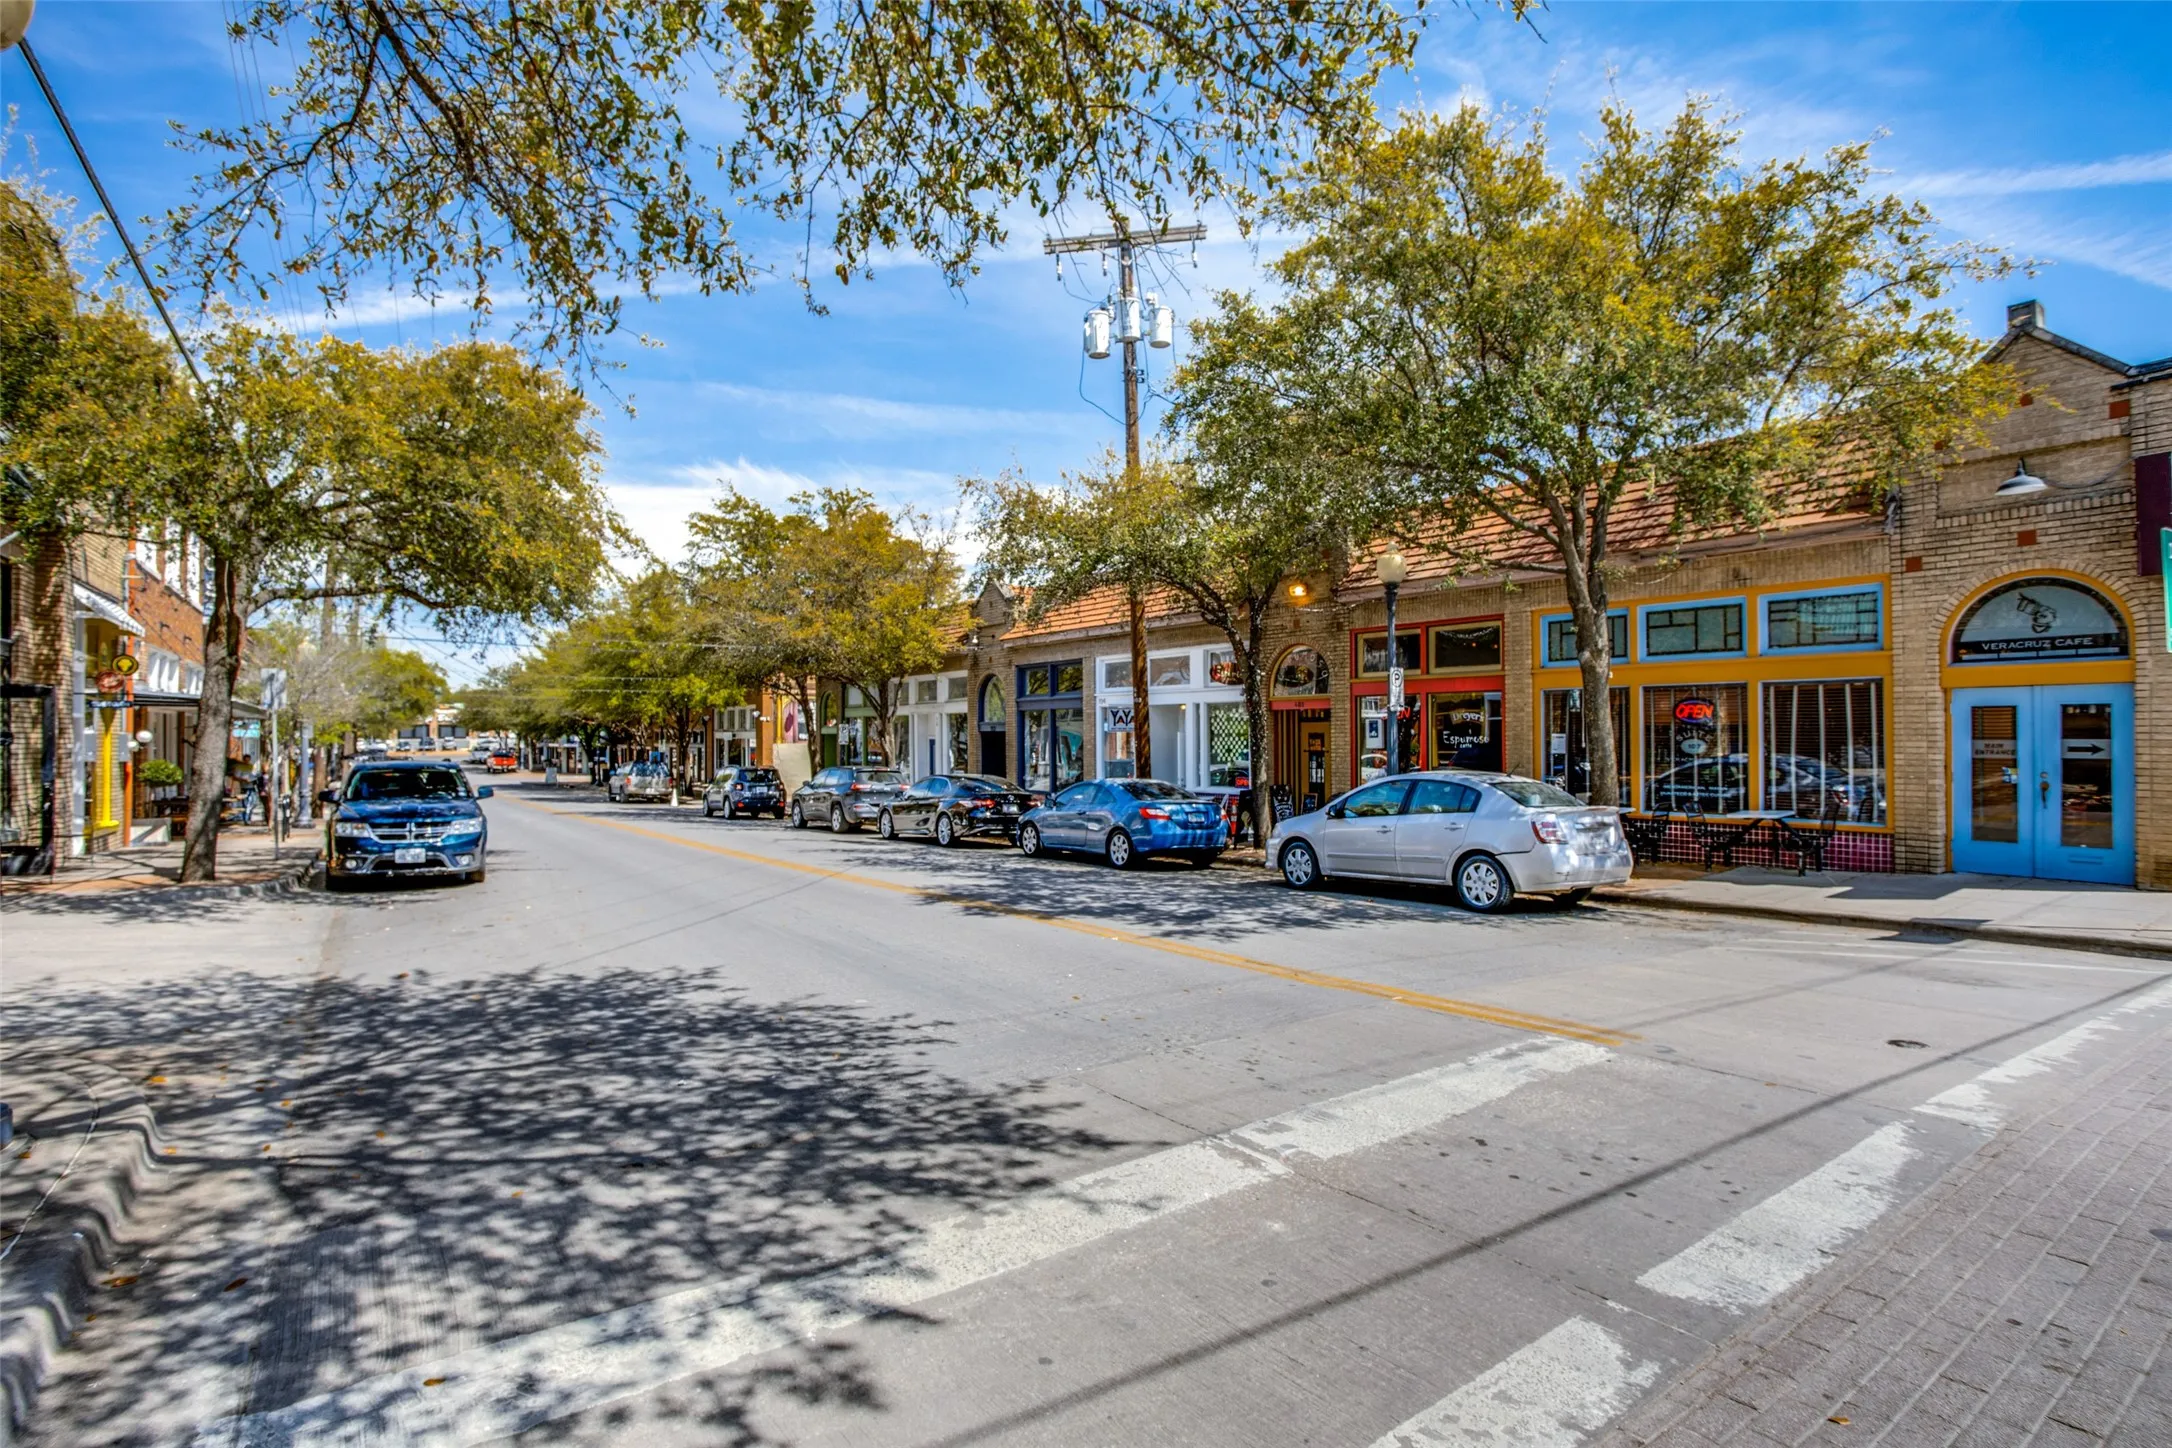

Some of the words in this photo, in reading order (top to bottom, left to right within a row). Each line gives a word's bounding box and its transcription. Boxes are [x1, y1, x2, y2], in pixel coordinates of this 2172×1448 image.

[1982, 639, 2051, 650] VERACRUZ
[2055, 637, 2093, 647] CAFE
[1394, 672, 1401, 684] P
[1675, 704, 1714, 718] OPEN
[1443, 730, 1490, 749] Espumoso
[1676, 730, 1715, 743] SUITE
